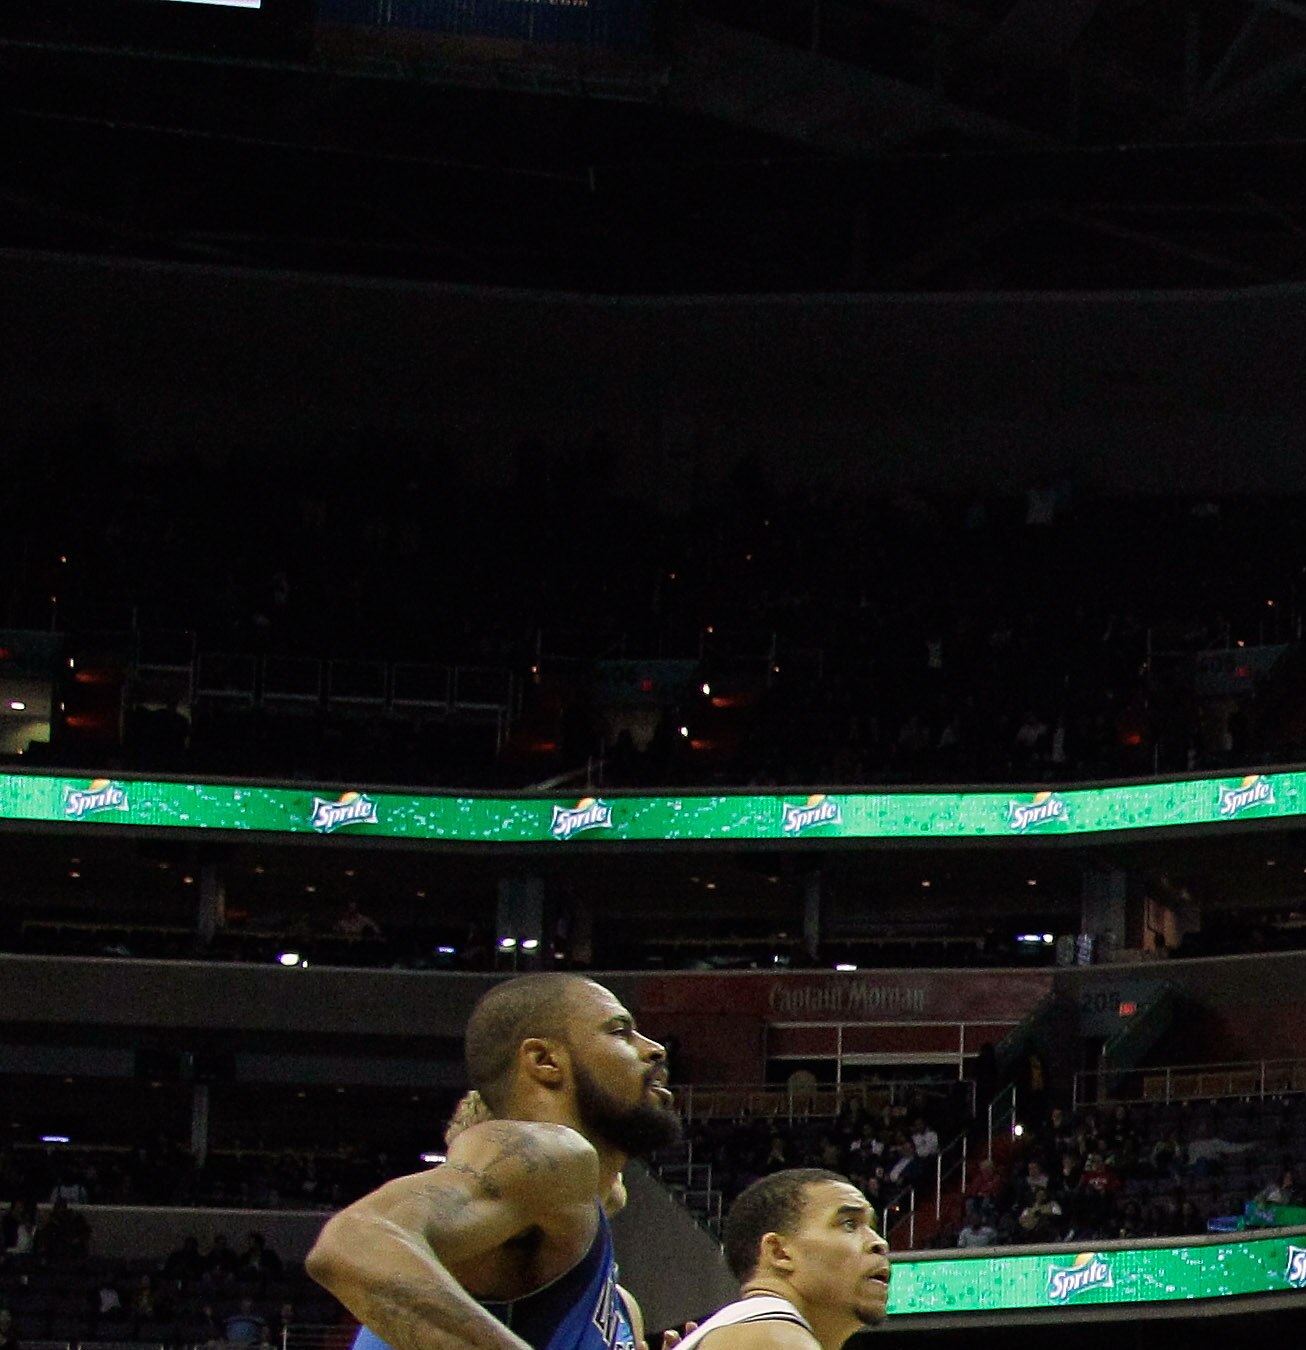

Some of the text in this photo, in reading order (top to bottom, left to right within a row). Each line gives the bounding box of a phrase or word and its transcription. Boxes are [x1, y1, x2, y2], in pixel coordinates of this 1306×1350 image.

[66, 786, 121, 815] Sprite
[1220, 782, 1270, 815] Sprite
[312, 801, 372, 830] Sprite
[552, 805, 607, 836] Sprite
[784, 802, 836, 832] Sprite
[1011, 800, 1061, 830] Sprite
[1048, 1258, 1107, 1300] Sprite
